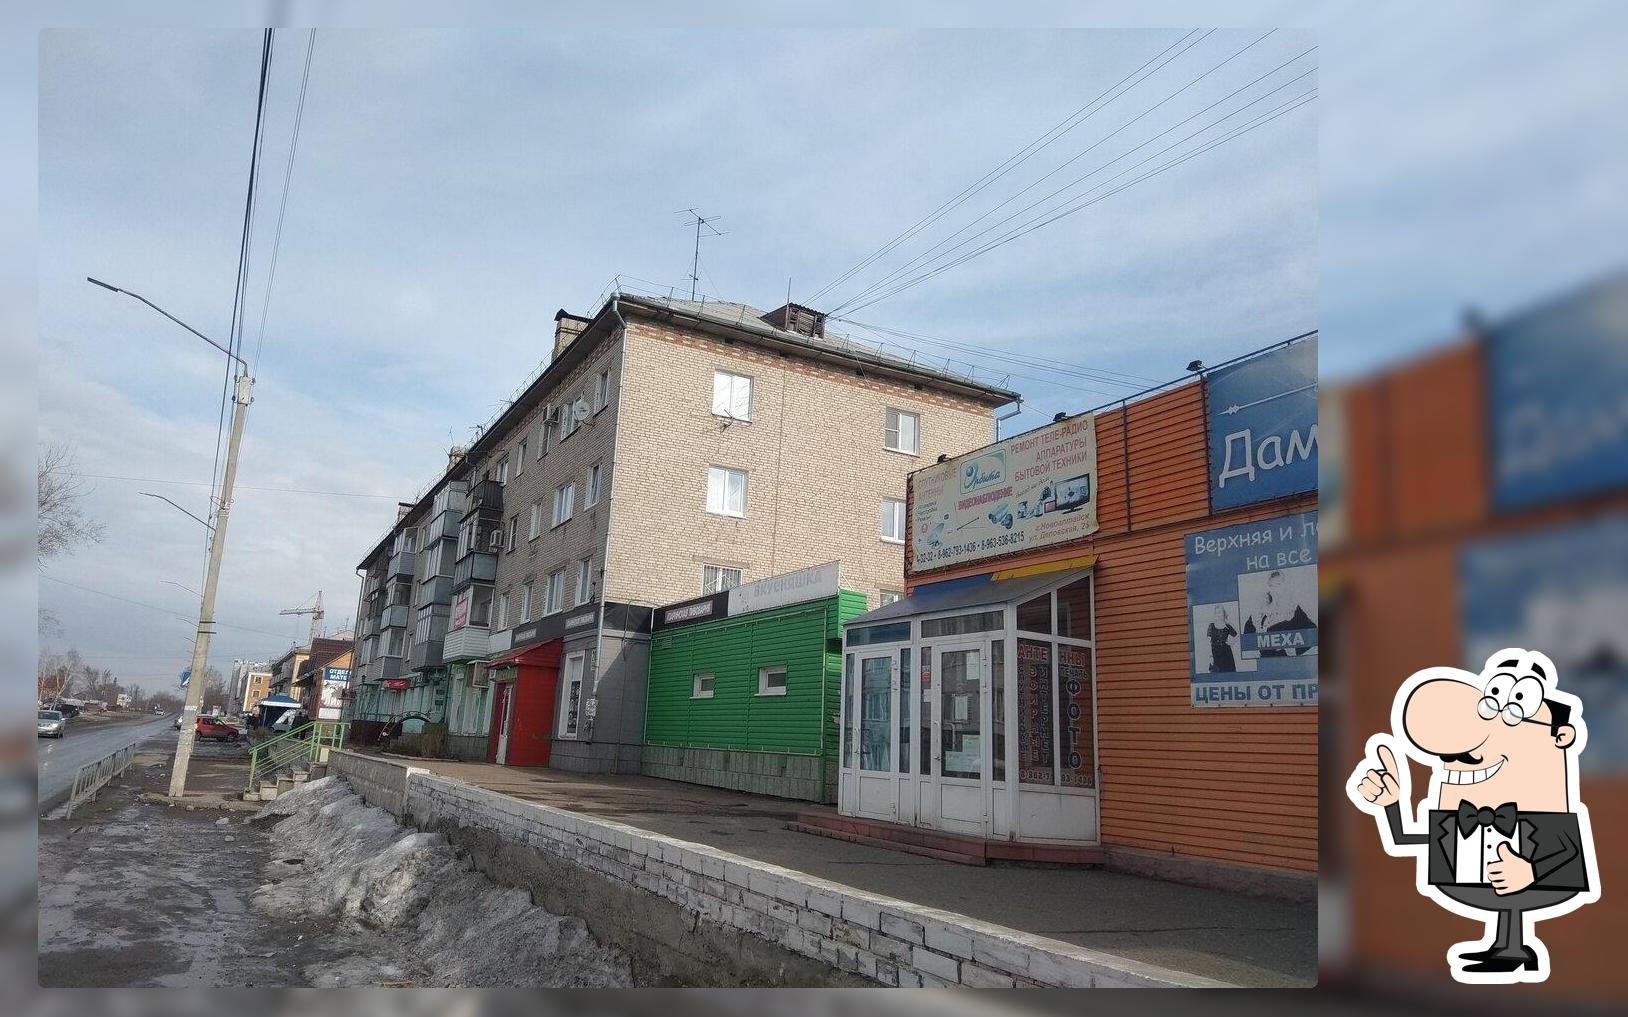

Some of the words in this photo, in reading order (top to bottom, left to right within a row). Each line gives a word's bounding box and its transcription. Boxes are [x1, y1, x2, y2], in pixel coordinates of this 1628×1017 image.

[1010, 436, 1039, 455] РЕМОНТ
[1041, 420, 1088, 443] ТЕЛЕ-РАДИО
[1036, 437, 1087, 462] АППАРАТУРЫ
[1014, 460, 1050, 482] БЫТОВОЙ
[1052, 451, 1087, 470] ТЕХНИКИ
[1195, 530, 1272, 557] Верхняя
[1280, 526, 1293, 540] и
[1301, 521, 1318, 537] л
[1246, 555, 1270, 570] на
[1276, 548, 1312, 566] все
[753, 569, 823, 598] ВКУСНЯШКА
[1257, 633, 1305, 648] МЕХА
[1195, 686, 1251, 703] ЦЕНЫ
[1258, 684, 1285, 700] ОТ
